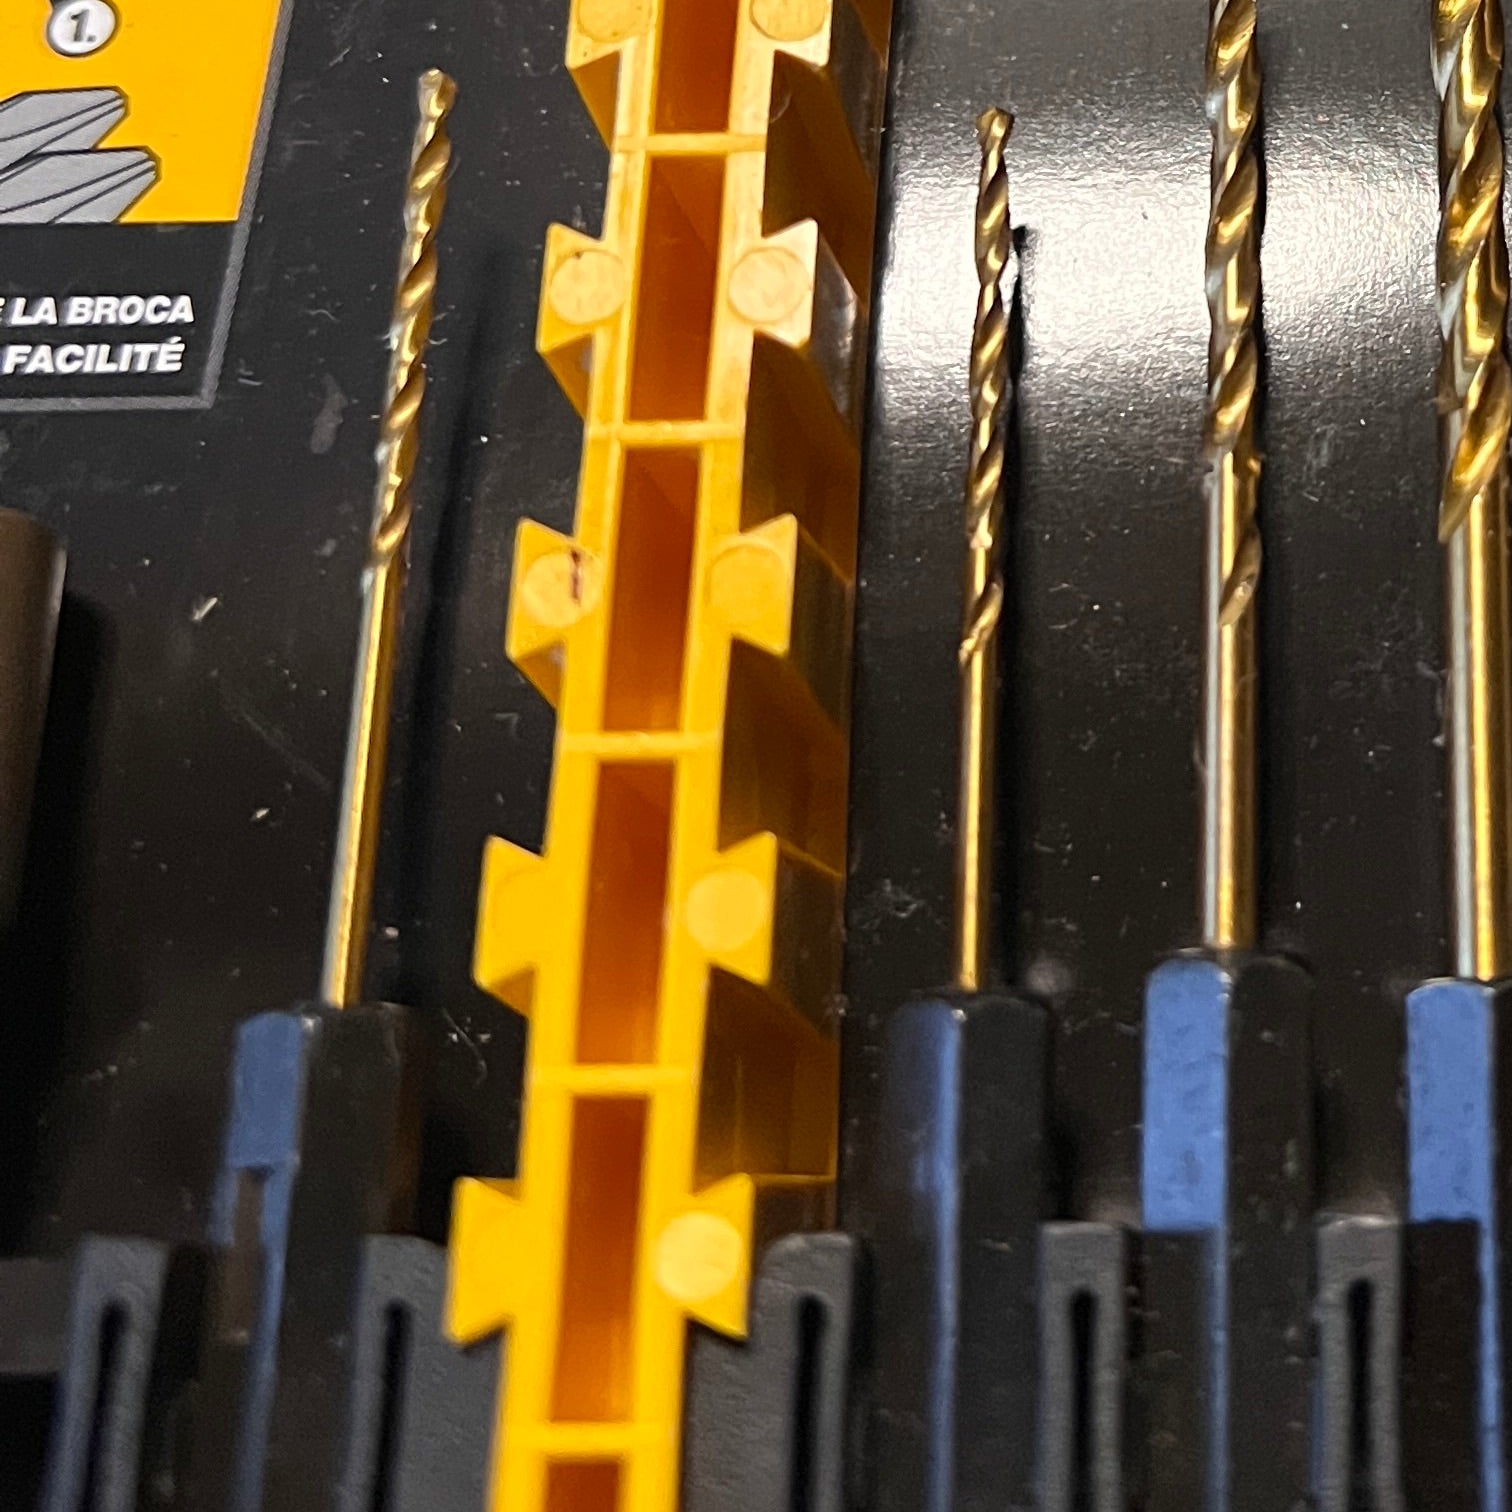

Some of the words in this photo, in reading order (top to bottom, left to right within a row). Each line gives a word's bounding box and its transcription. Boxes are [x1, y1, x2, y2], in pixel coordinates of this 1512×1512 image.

[10, 296, 58, 325] LA
[65, 295, 196, 325] BROCA
[2, 337, 185, 374] FACILITÉ
